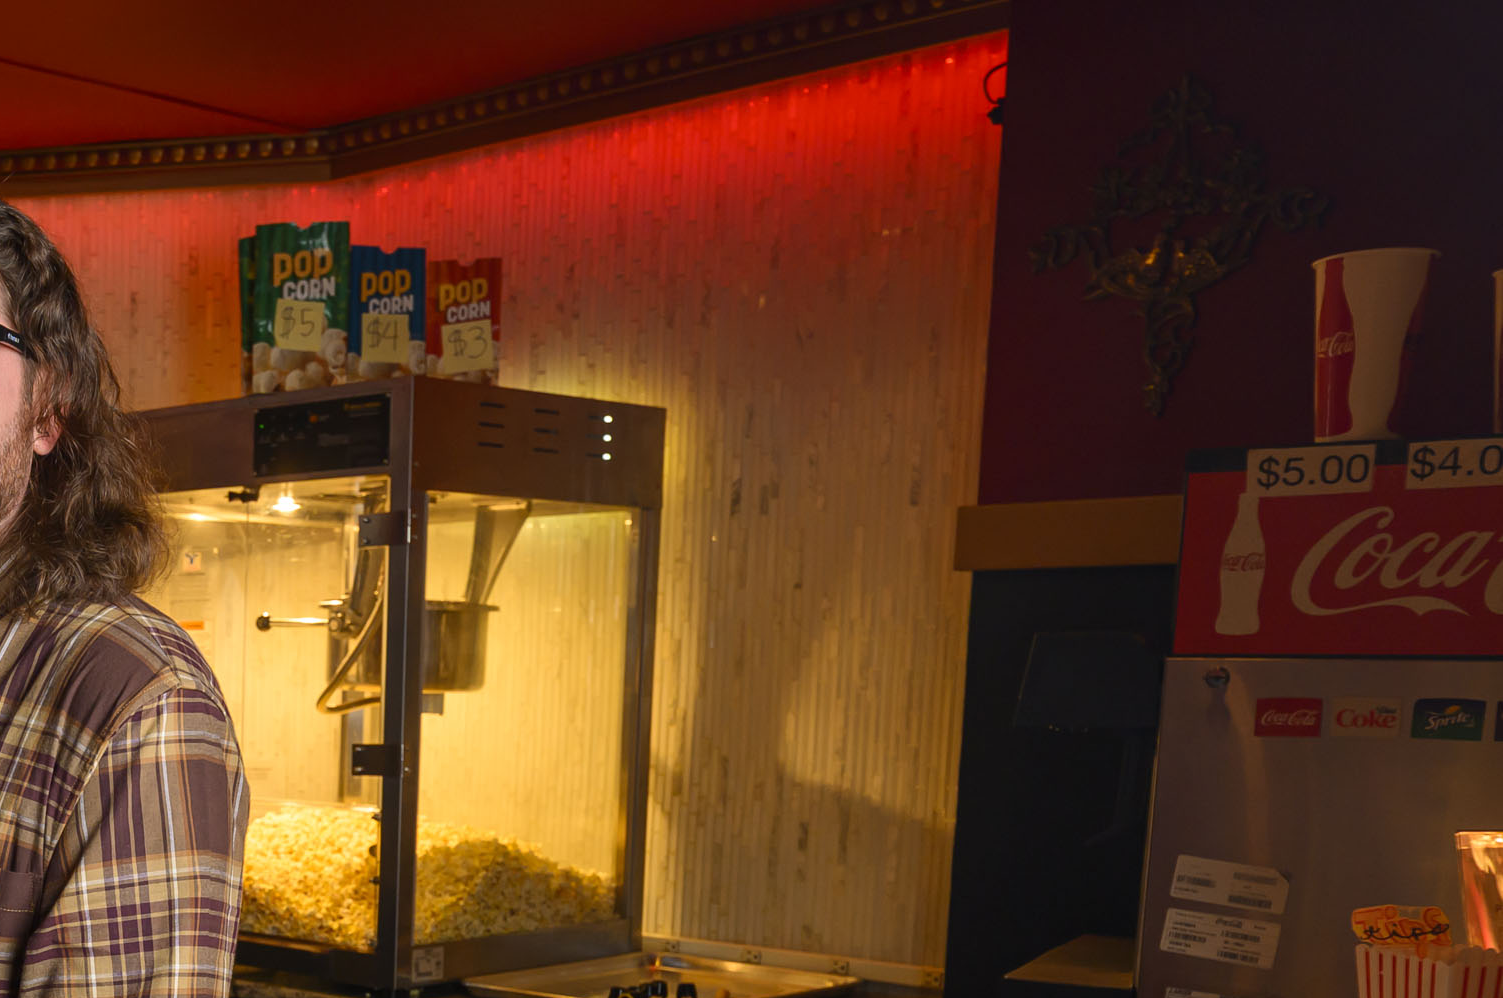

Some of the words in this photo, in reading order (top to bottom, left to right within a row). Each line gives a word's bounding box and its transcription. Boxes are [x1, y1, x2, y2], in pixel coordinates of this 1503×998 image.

[273, 249, 333, 287] POP
[283, 276, 336, 300] CORN
[361, 269, 411, 302] POP
[439, 278, 488, 311] POP
[369, 294, 414, 315] CORN
[447, 301, 491, 323] CORN
[279, 306, 315, 340] $5
[365, 319, 399, 350] $4
[448, 325, 489, 359] $3
[1257, 454, 1370, 490] $5.00
[1336, 709, 1397, 729] Coke
[1424, 711, 1472, 731] Sprite
